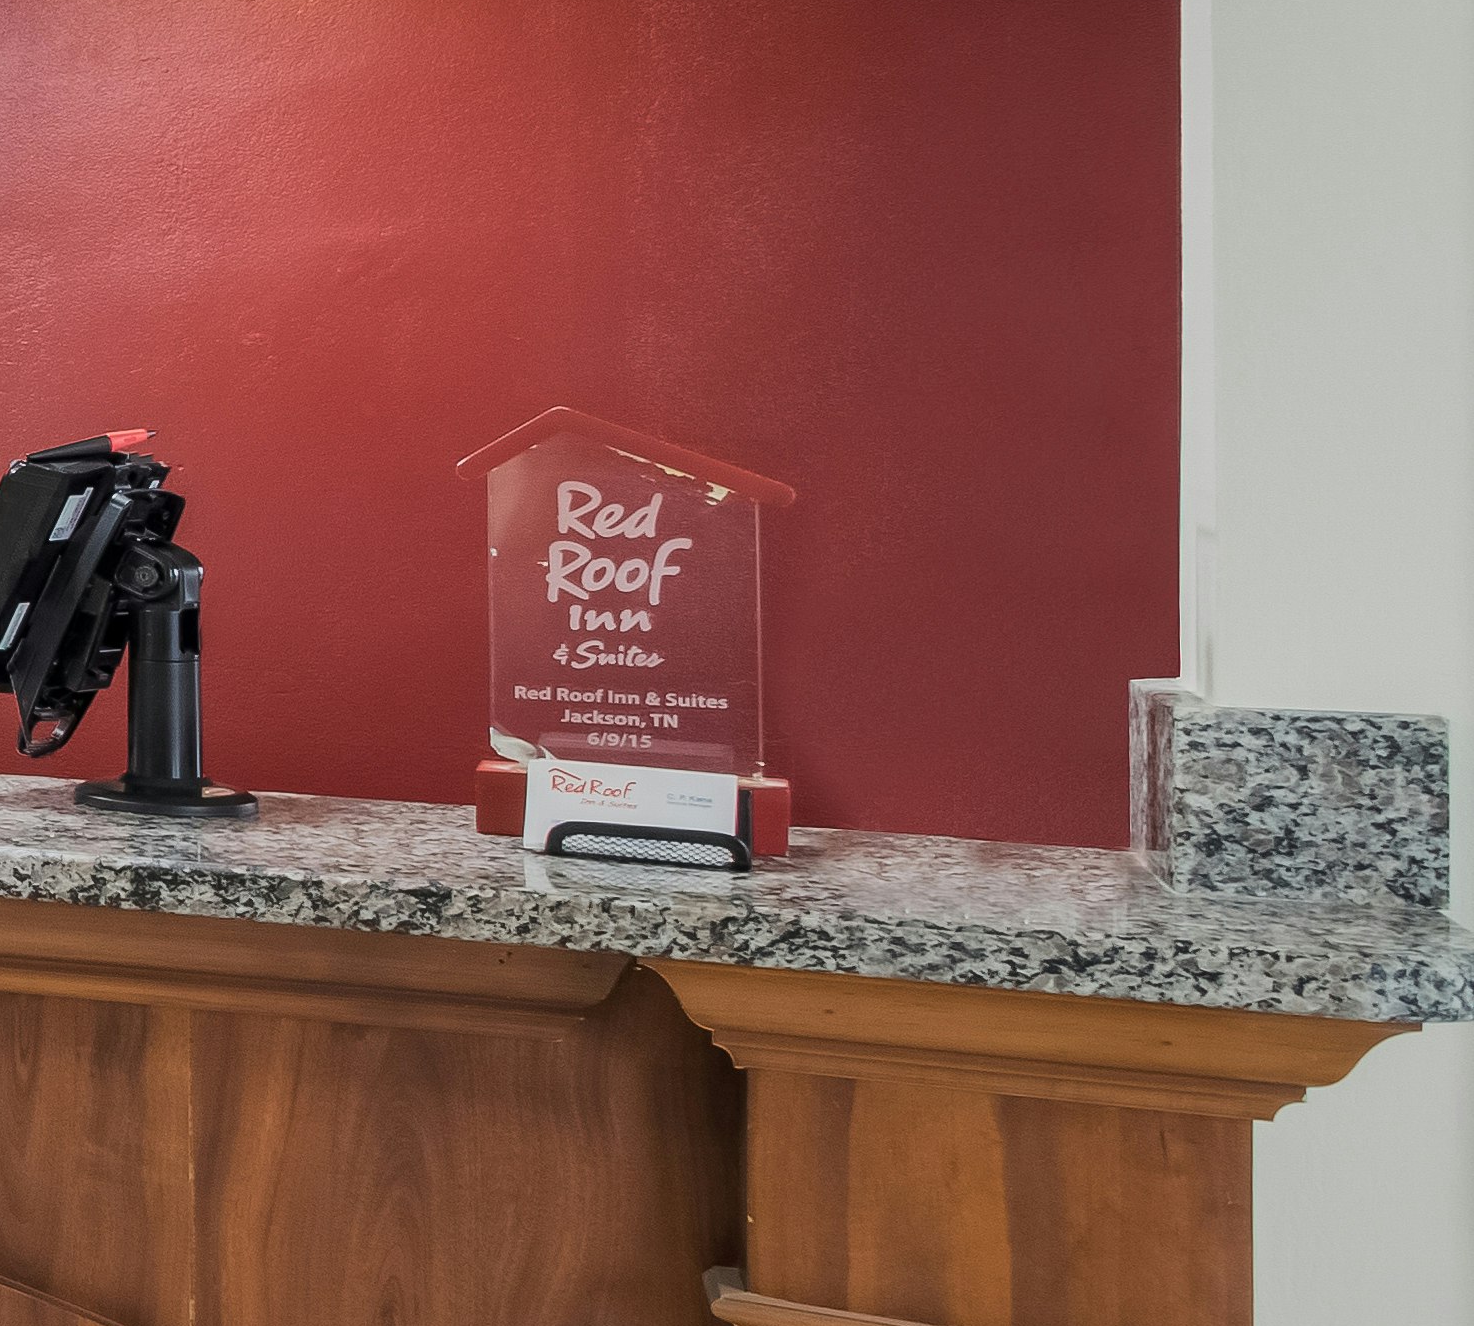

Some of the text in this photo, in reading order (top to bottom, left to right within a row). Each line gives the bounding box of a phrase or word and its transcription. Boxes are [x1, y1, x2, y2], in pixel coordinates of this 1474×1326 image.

[557, 481, 663, 539] Red
[546, 538, 692, 606] Roof
[569, 604, 652, 632] Inn
[552, 639, 665, 669] & Suites
[514, 685, 728, 709] Red Roof Inn & Suites
[561, 709, 679, 728] Jackson, TN
[586, 732, 652, 748] 6/9/15
[551, 775, 637, 798] Red Roof
